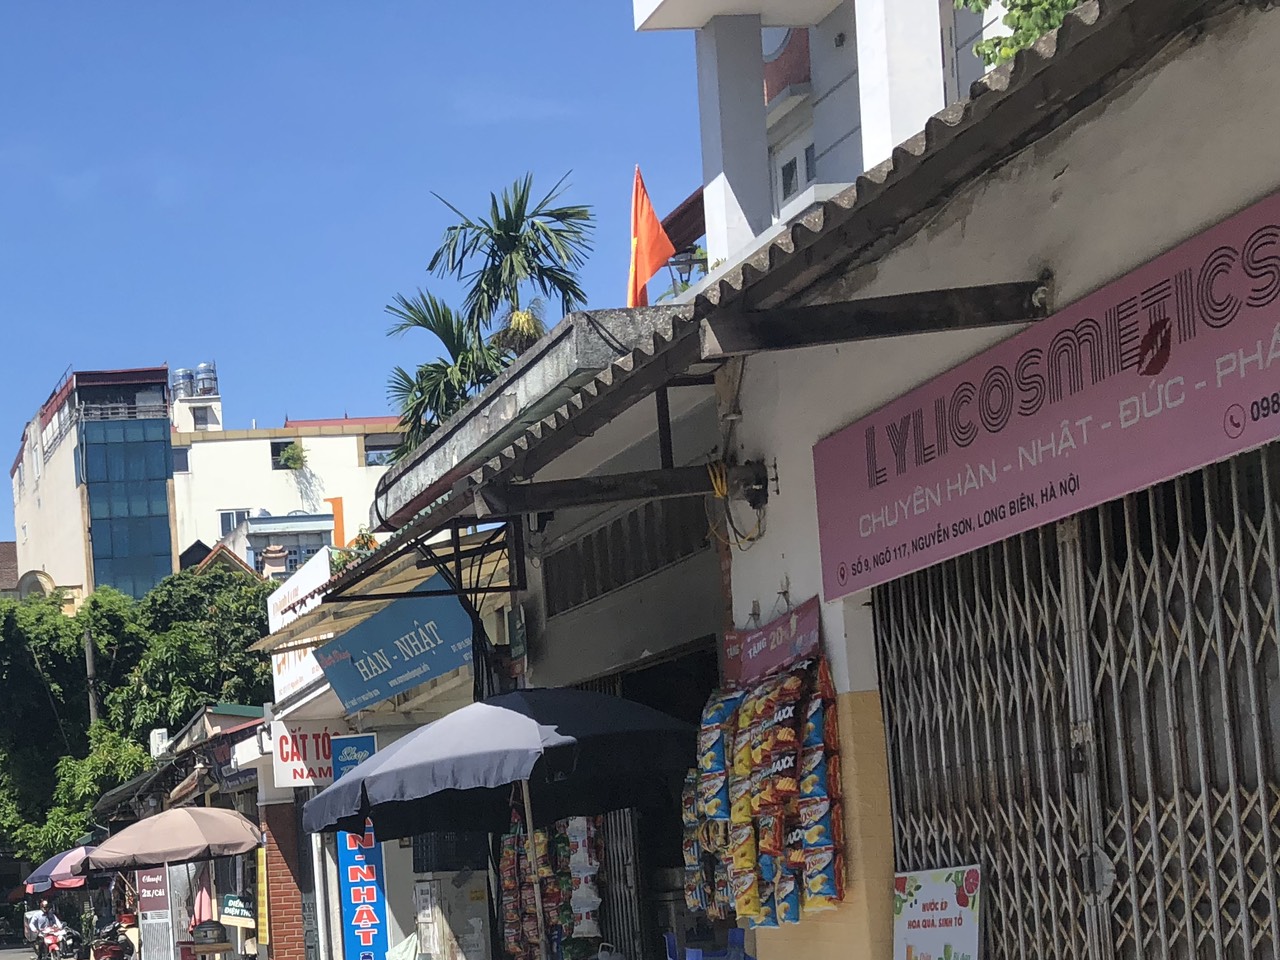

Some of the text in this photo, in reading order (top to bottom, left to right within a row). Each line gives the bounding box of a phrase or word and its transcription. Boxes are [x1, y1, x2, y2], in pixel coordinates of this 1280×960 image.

[859, 483, 942, 537] CHUYÊN
[947, 459, 997, 501] HÀN
[1018, 416, 1093, 471] NHẬT
[1119, 376, 1186, 429] ĐỨC
[851, 557, 864, 576] SỐ
[872, 547, 891, 569] NGÕ
[893, 543, 910, 561] 117,
[911, 523, 950, 552] NGUYỄN
[977, 504, 1006, 528] LONG
[1040, 487, 1057, 505] HÀ
[1059, 473, 1080, 497] NỘI
[354, 648, 392, 682] HÀN
[394, 619, 444, 662] NHẬT
[280, 726, 342, 763] CẮT TÓ
[339, 746, 370, 765] Shop
[292, 766, 333, 780] NAM
[907, 920, 921, 929] HOA
[938, 918, 953, 928] SINH
[954, 910, 963, 927] TỐ
